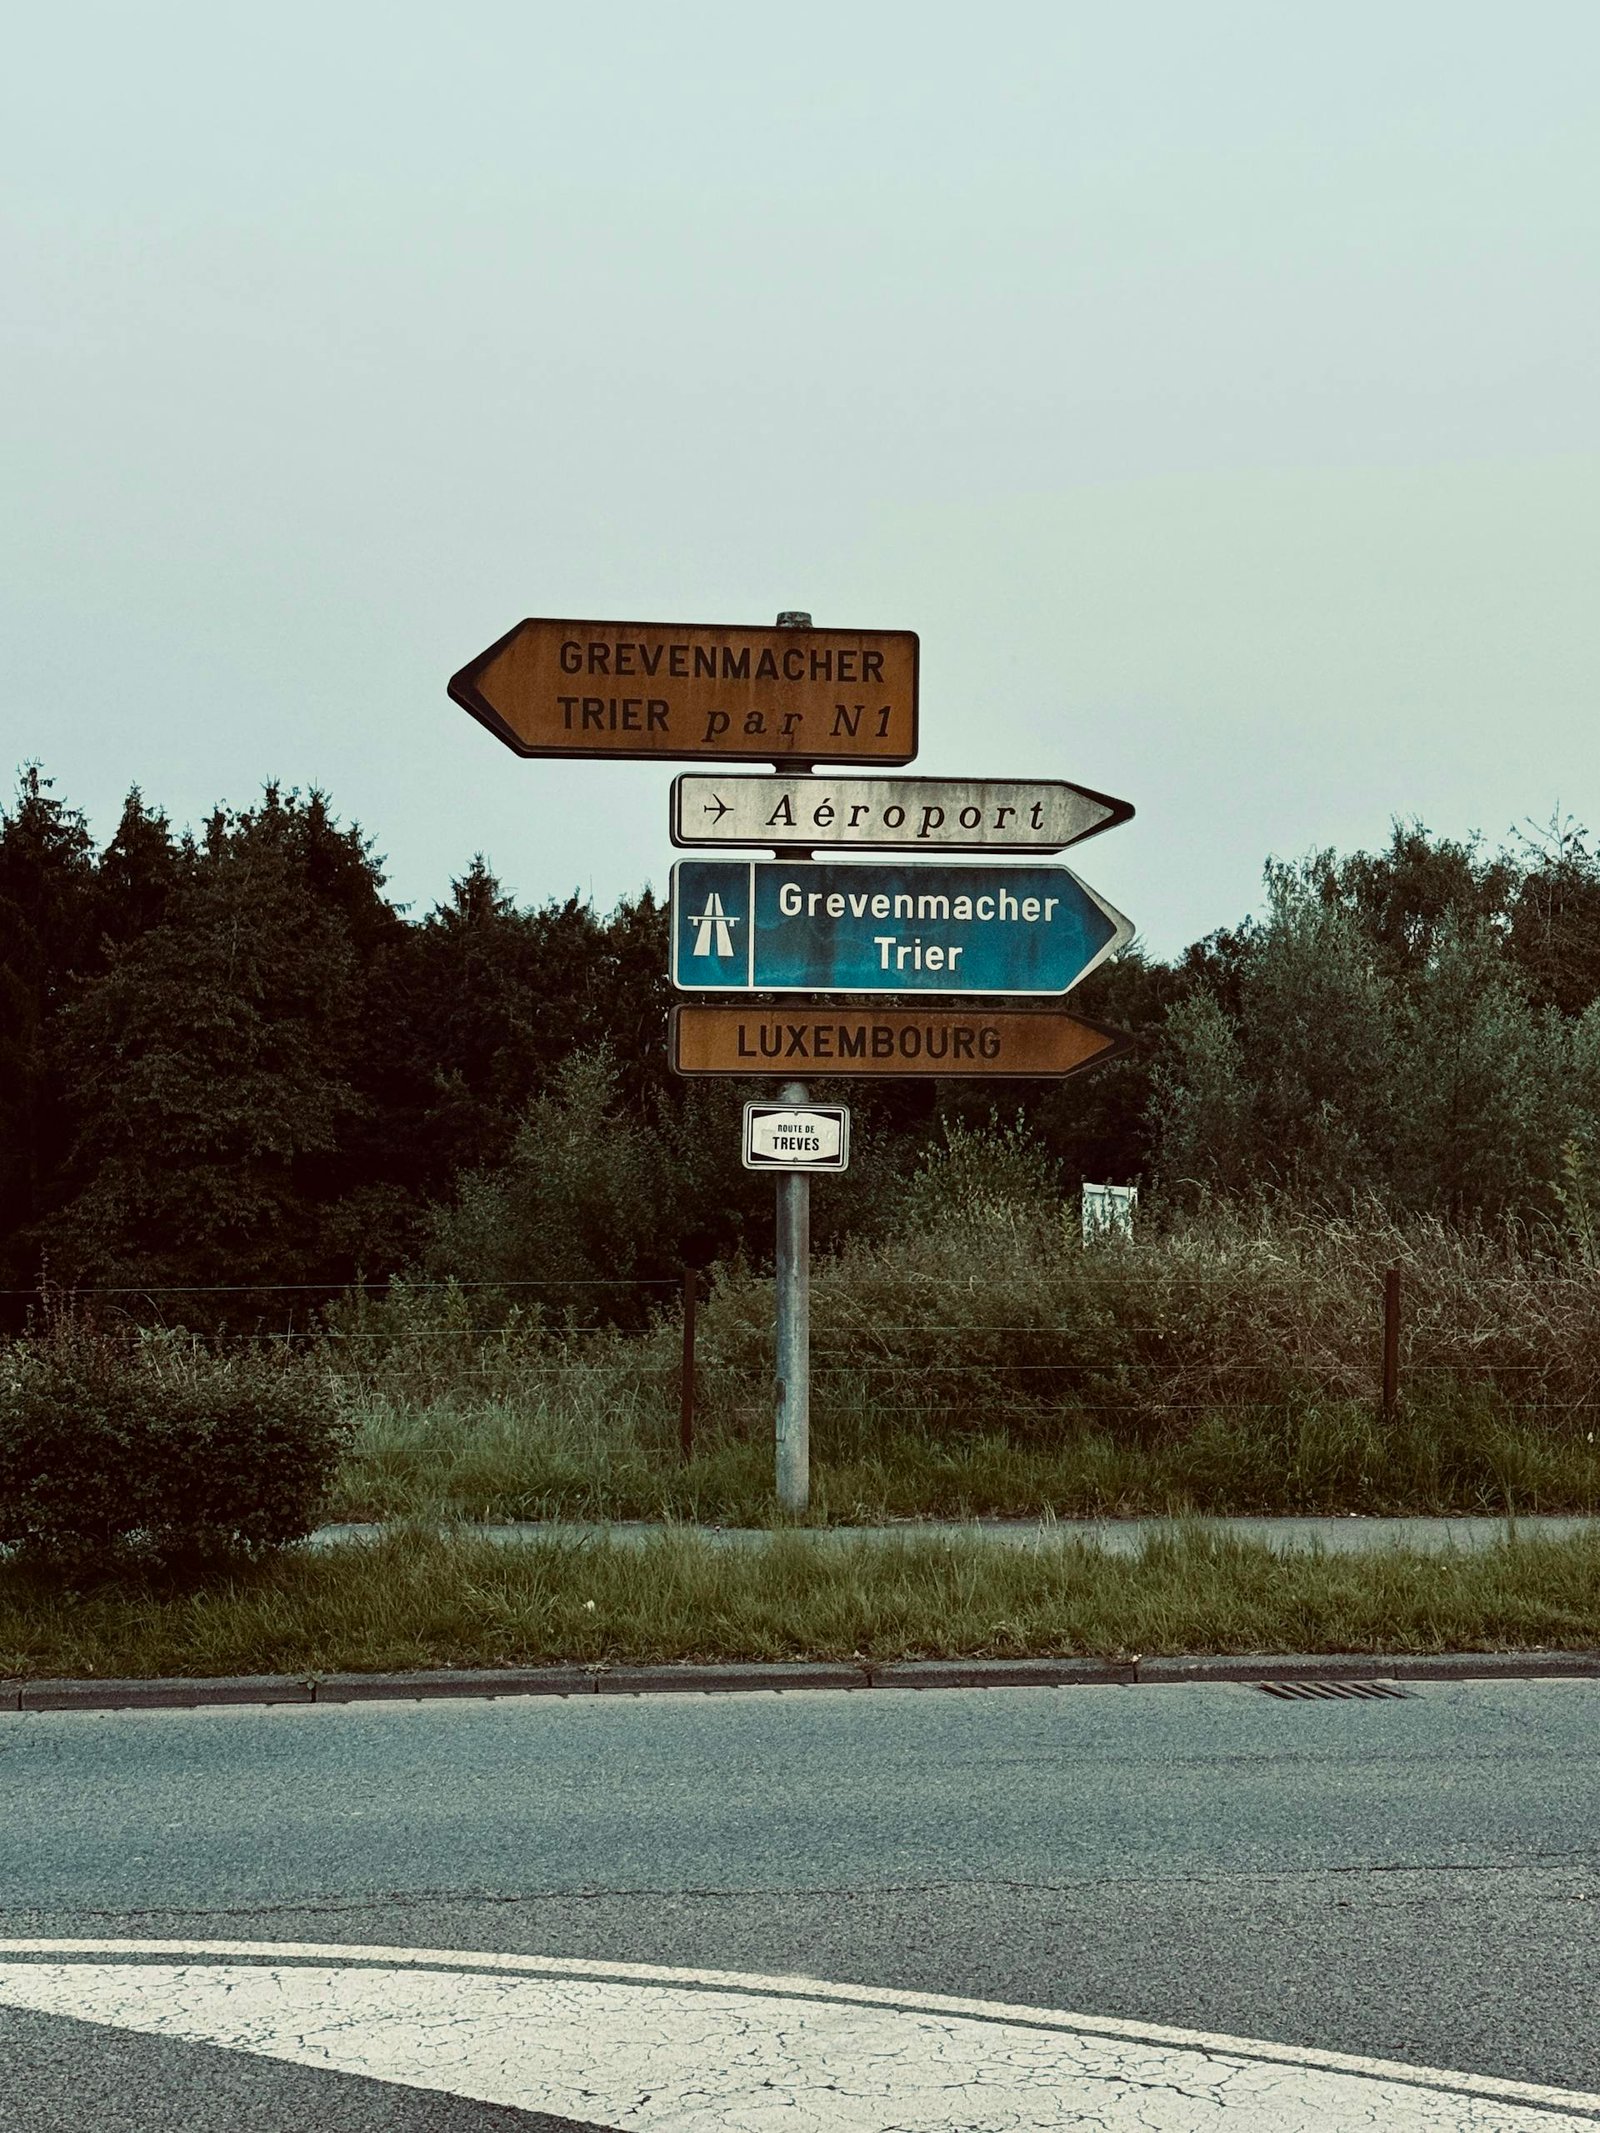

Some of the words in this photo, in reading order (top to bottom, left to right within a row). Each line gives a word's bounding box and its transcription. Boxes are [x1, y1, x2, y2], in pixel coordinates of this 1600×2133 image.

[560, 640, 885, 684] GREVENMACHER
[557, 697, 670, 732] TRIER
[701, 708, 803, 743] par
[829, 704, 892, 738] N1
[765, 794, 1045, 838] Aéroport
[778, 882, 1060, 922] Grevenmacher
[874, 936, 964, 970] Trier
[738, 1024, 1001, 1060] LUXEMBOURG
[772, 1136, 820, 1151] TREVES
[777, 1124, 802, 1133] ROUTE
[805, 1125, 815, 1133] DE
